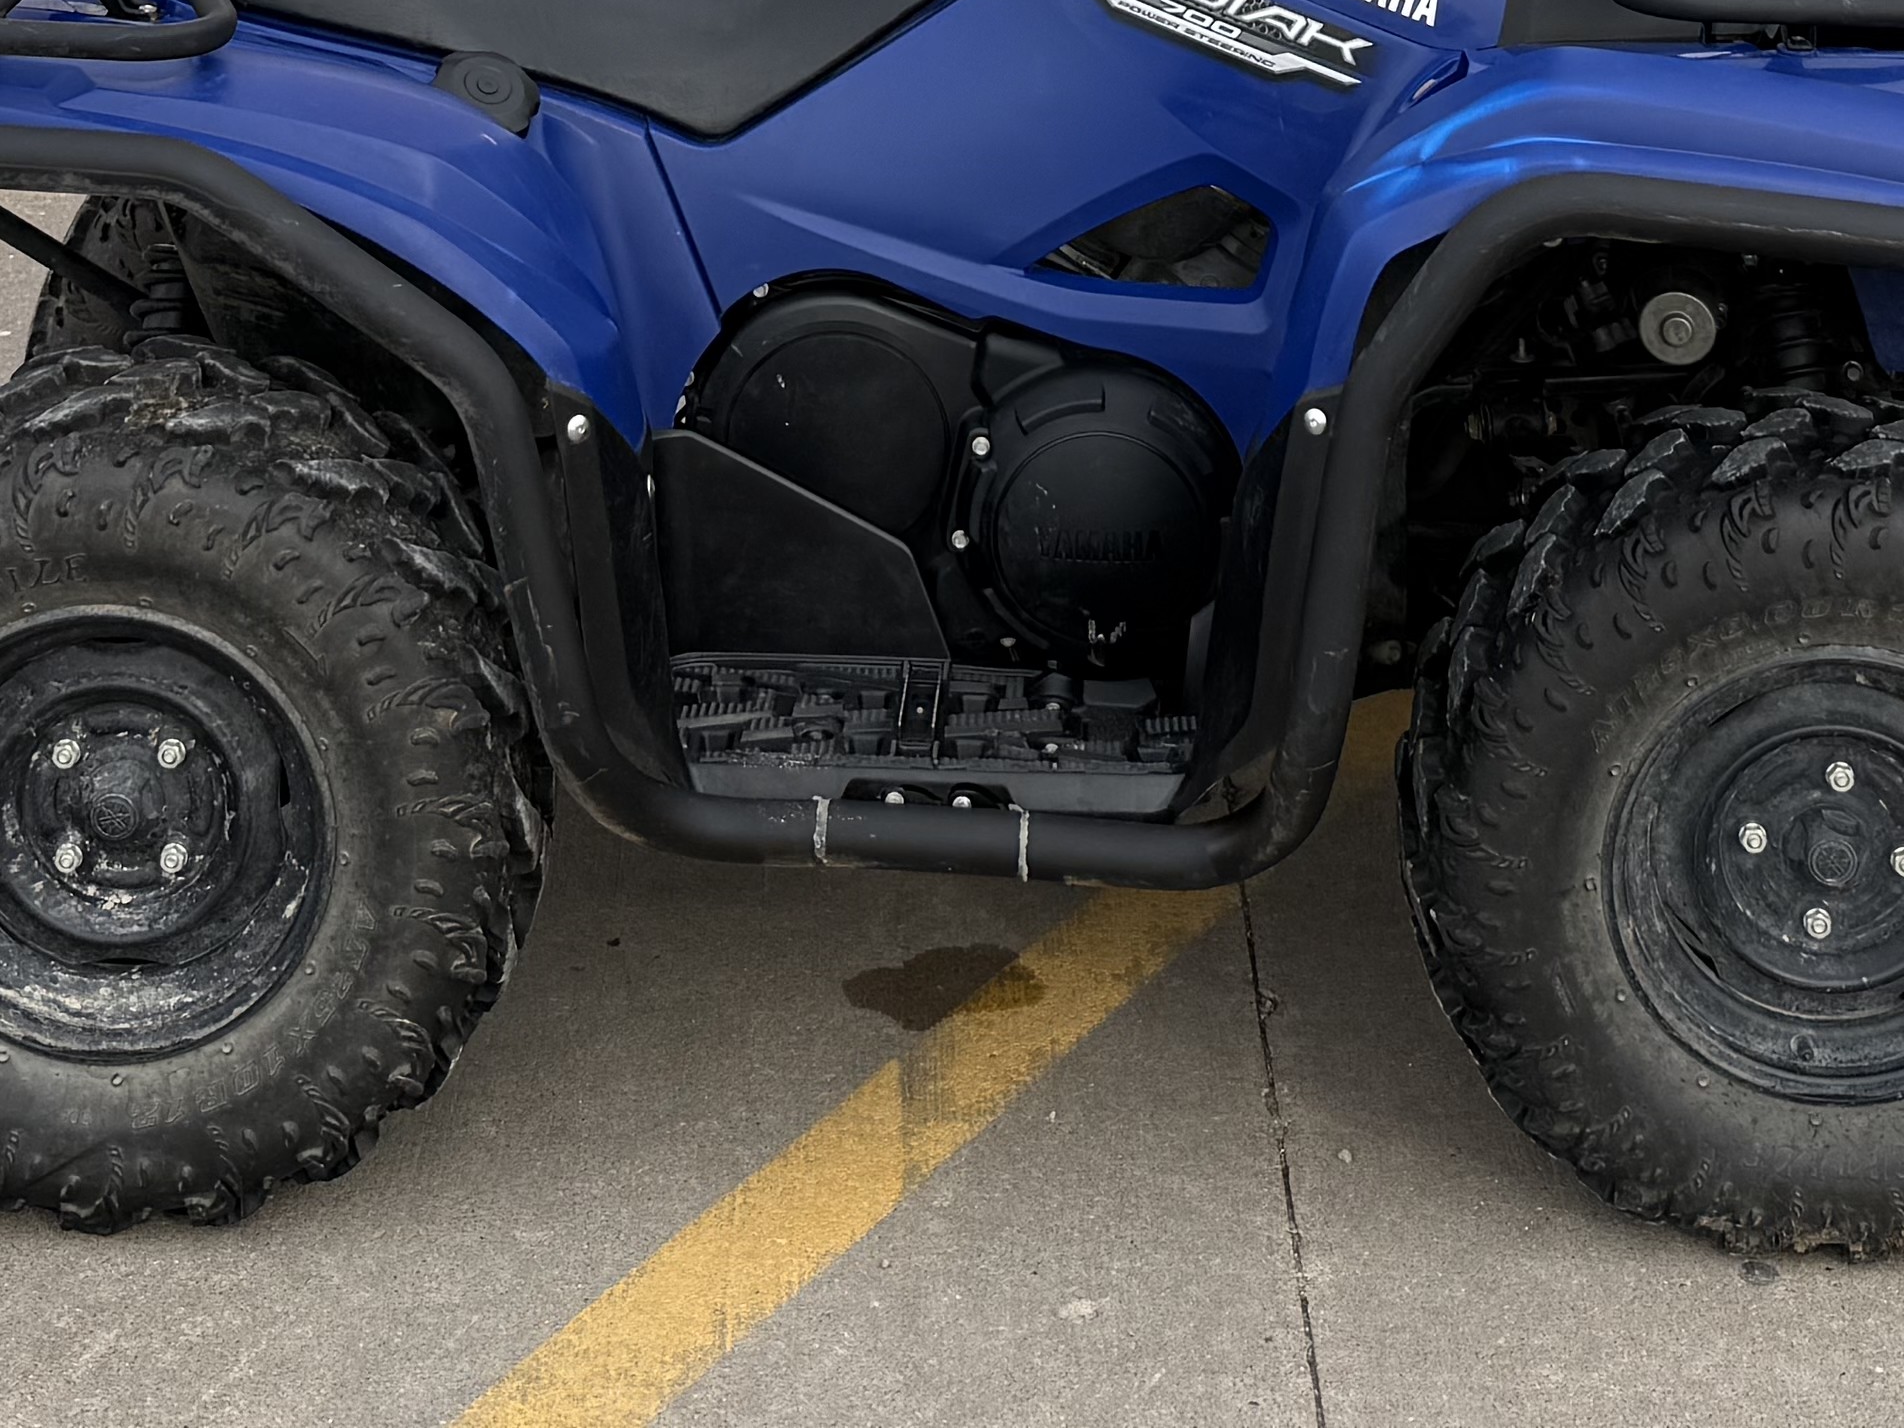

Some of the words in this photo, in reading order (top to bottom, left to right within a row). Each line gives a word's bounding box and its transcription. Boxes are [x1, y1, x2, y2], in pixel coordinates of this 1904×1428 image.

[1117, 0, 1180, 31] POWER
[1184, 25, 1277, 69] STEERING
[1034, 527, 1164, 564] YAMAHA
